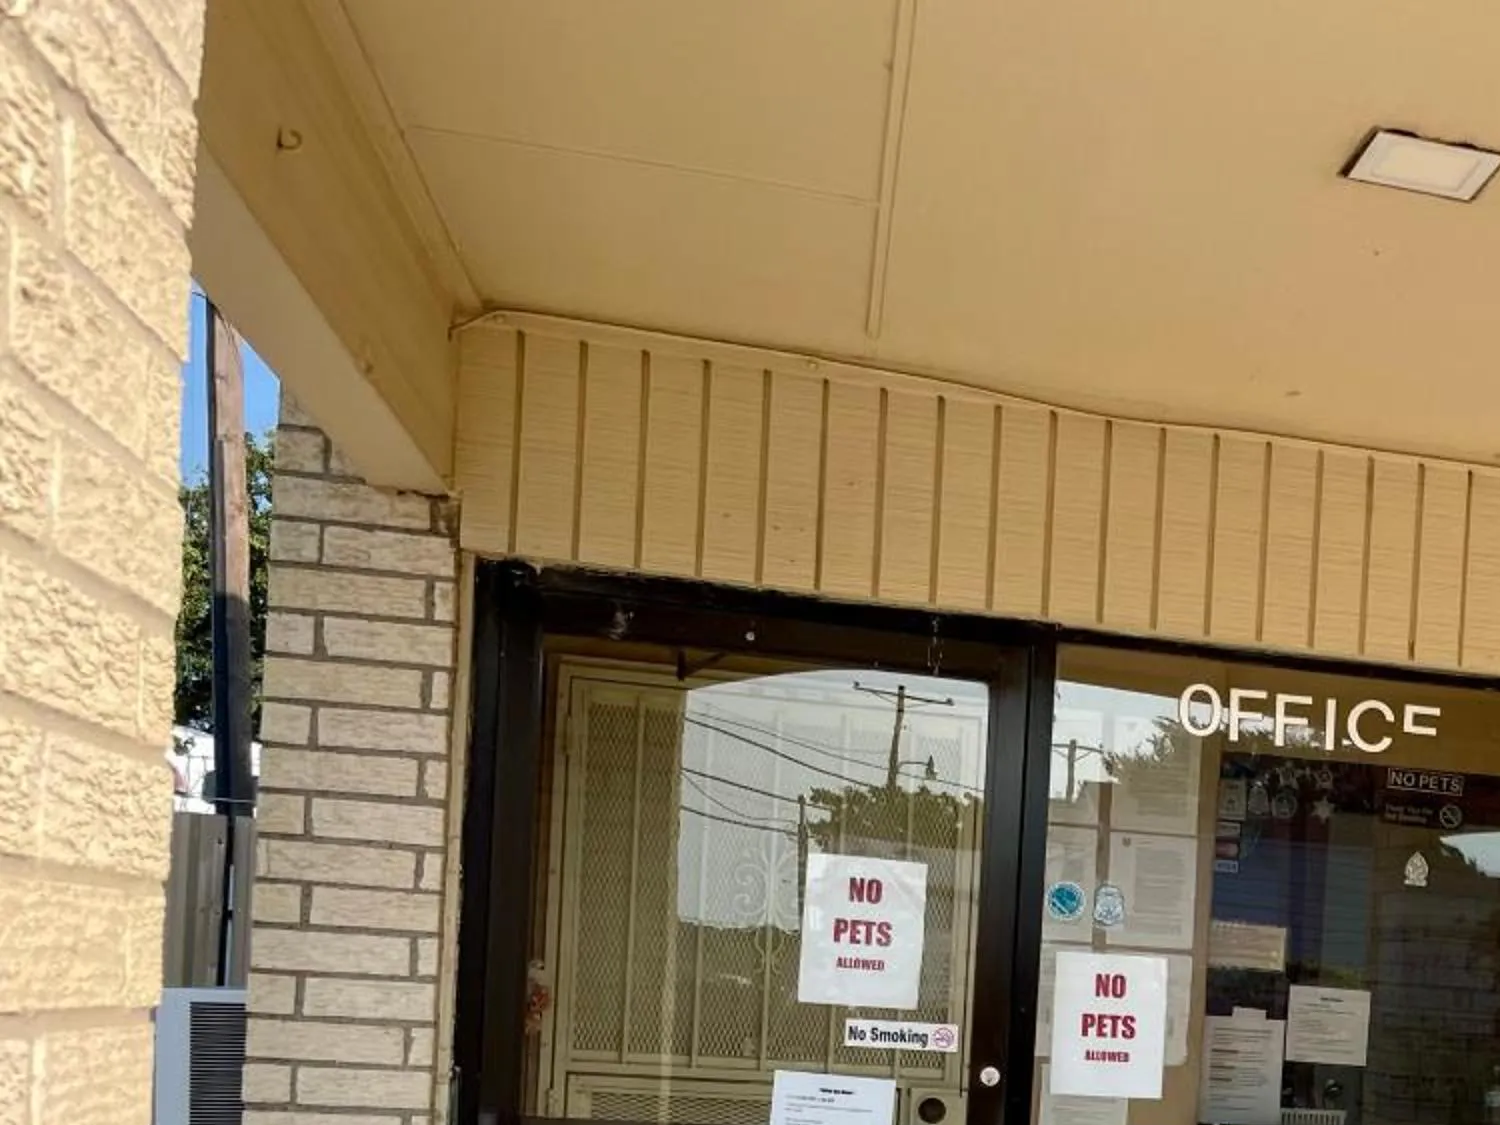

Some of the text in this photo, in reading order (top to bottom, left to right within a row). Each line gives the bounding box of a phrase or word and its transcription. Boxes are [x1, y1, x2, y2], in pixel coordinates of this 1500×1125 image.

[1179, 682, 1441, 753] OFFICE
[1391, 771, 1460, 793] NO PETS
[849, 877, 883, 904] NO
[833, 918, 894, 947] PETS
[835, 956, 886, 972] ALLOWED
[1095, 973, 1127, 999] NO
[848, 1026, 929, 1048] No Smoking
[1081, 1013, 1137, 1040] PETS
[1085, 1049, 1130, 1063] ALLOWED
